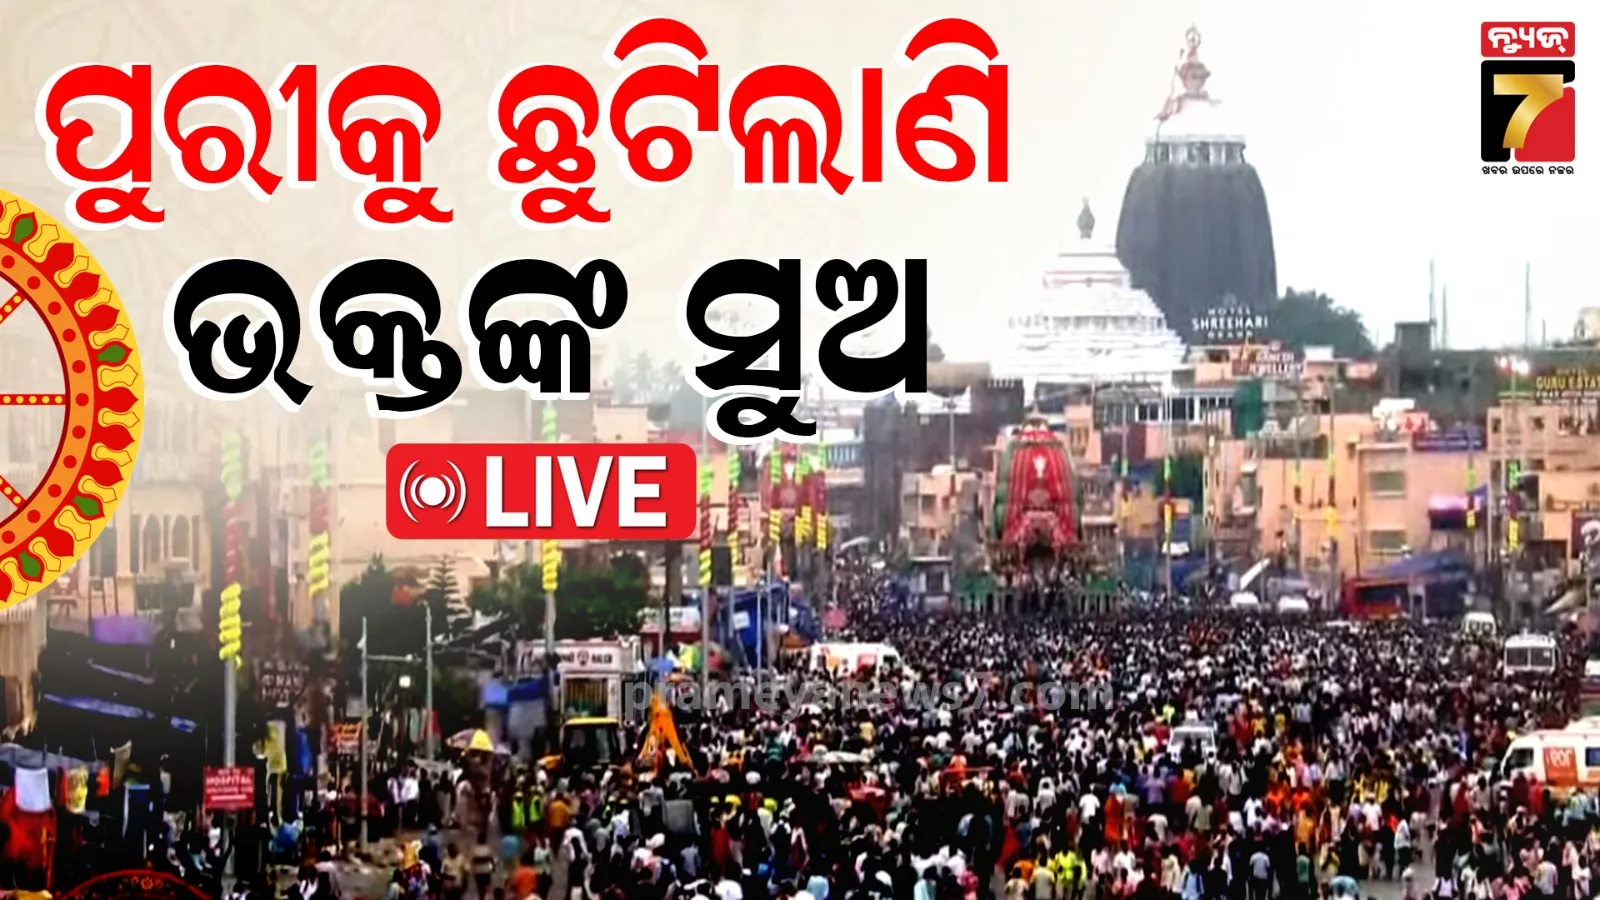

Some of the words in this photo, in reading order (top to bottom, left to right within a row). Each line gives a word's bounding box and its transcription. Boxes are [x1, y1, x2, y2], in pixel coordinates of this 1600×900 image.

[1208, 306, 1251, 315] HOTEL
[1192, 315, 1268, 331] SHREEHARI
[1536, 376, 1566, 390] GURU
